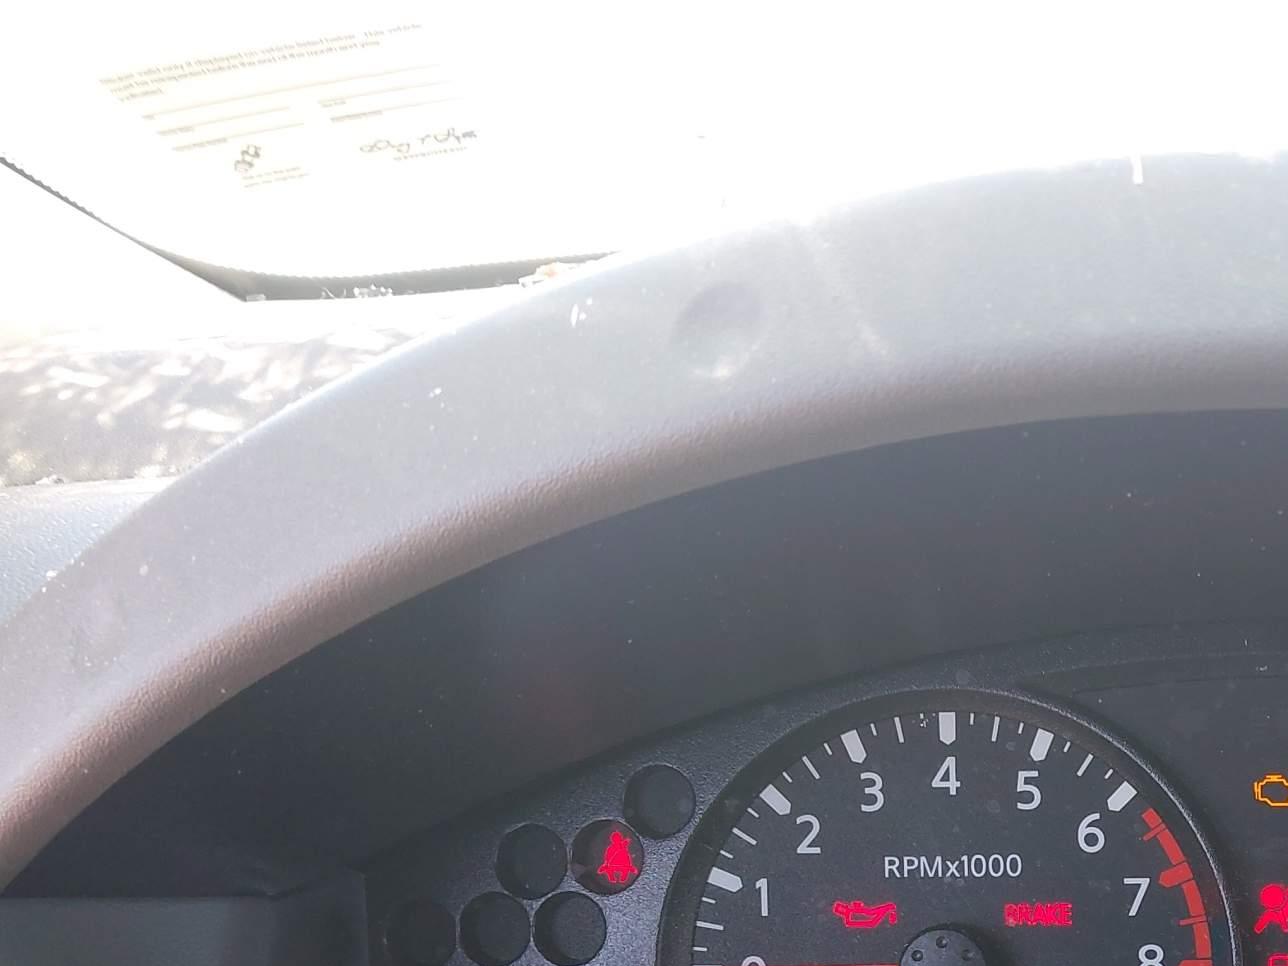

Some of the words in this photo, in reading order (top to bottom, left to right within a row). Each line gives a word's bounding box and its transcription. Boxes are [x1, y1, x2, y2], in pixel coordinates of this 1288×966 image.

[860, 773, 885, 813] 3
[932, 756, 960, 796] 4
[1017, 771, 1042, 811] 5
[796, 815, 822, 854] 2
[1077, 813, 1105, 853] 6
[884, 854, 1023, 879] RPMx1000
[755, 878, 769, 917] 1
[1004, 903, 1073, 927] BRAKE
[1123, 877, 1151, 917] 7
